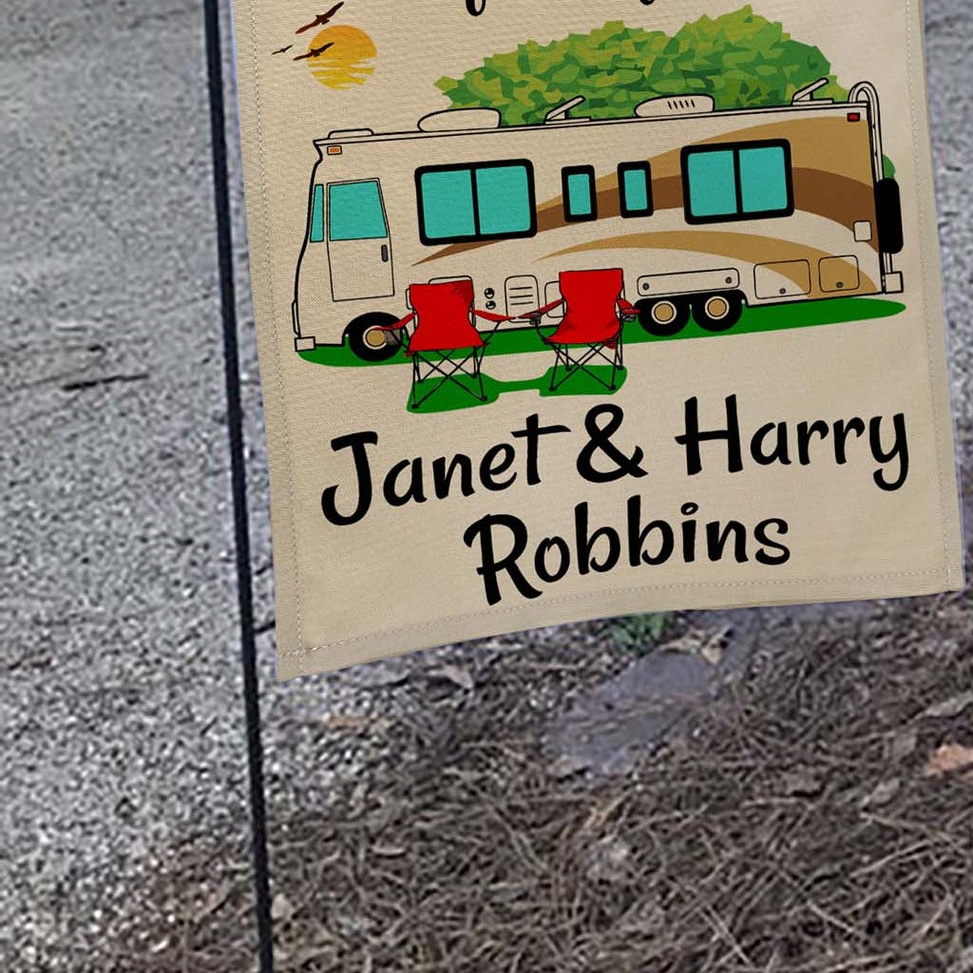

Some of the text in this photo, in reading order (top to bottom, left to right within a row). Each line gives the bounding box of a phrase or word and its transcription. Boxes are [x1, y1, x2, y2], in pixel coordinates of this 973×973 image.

[320, 393, 910, 527] Janet & Harry
[463, 494, 792, 606] Robbins
